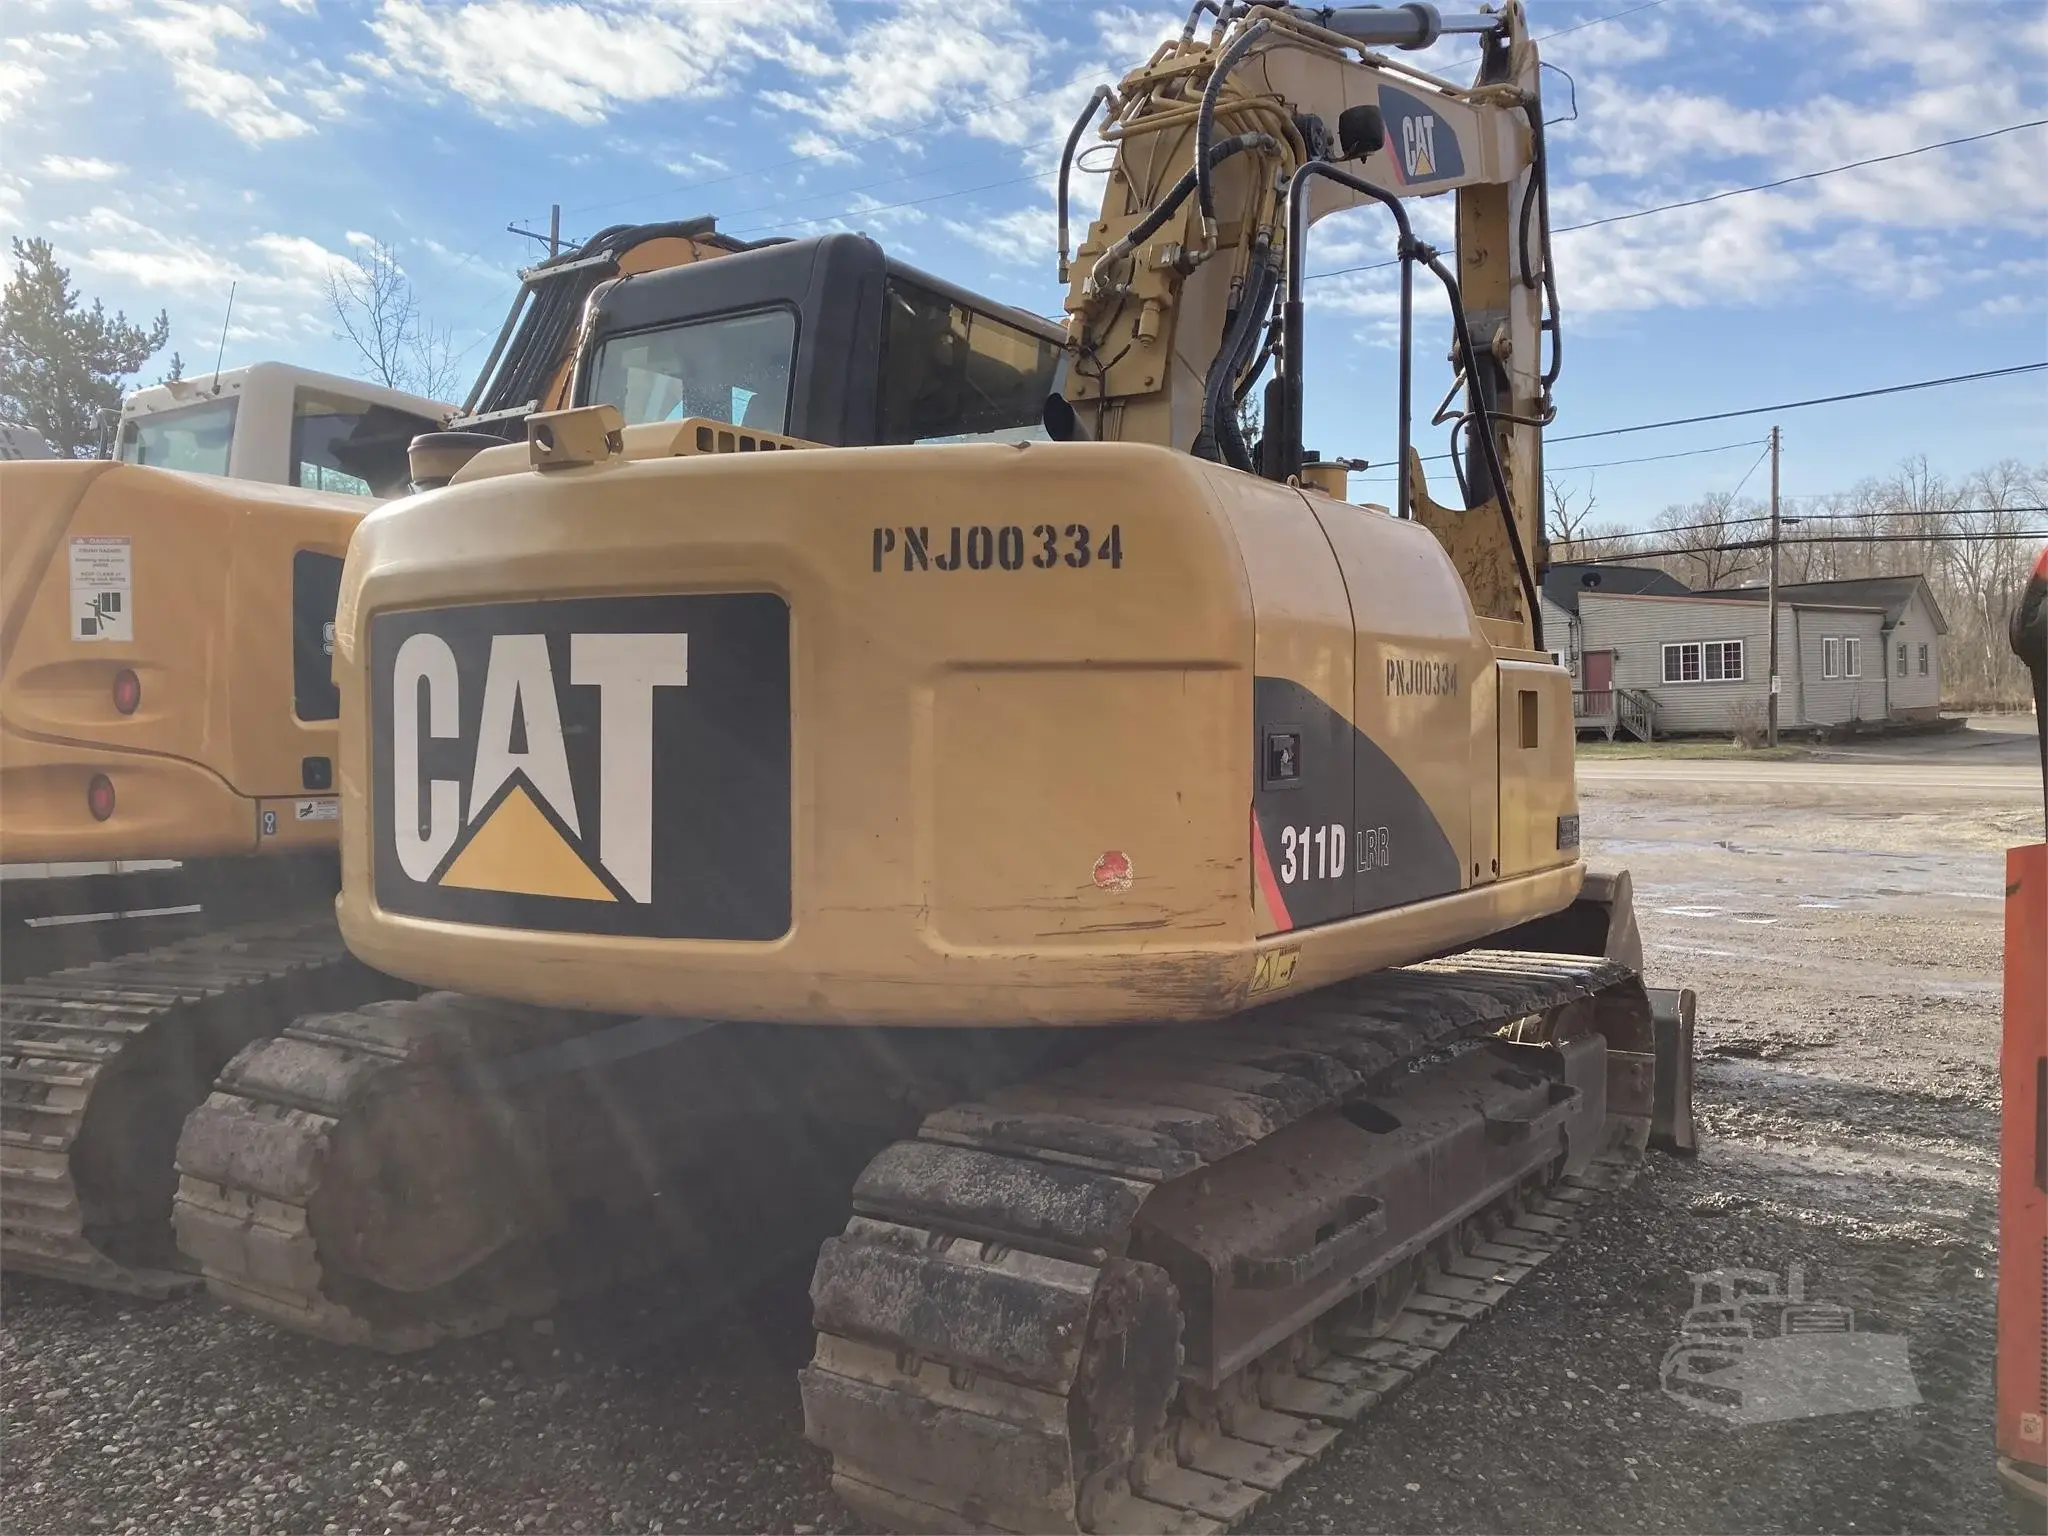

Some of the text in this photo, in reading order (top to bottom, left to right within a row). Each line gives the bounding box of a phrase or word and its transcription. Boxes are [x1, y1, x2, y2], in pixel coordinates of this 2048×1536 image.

[1402, 115, 1436, 176] CAT
[872, 523, 1123, 573] PNJ00334
[1386, 659, 1457, 697] PNJ00334
[393, 633, 688, 904] CAT
[1281, 823, 1389, 884] 311D LRR
